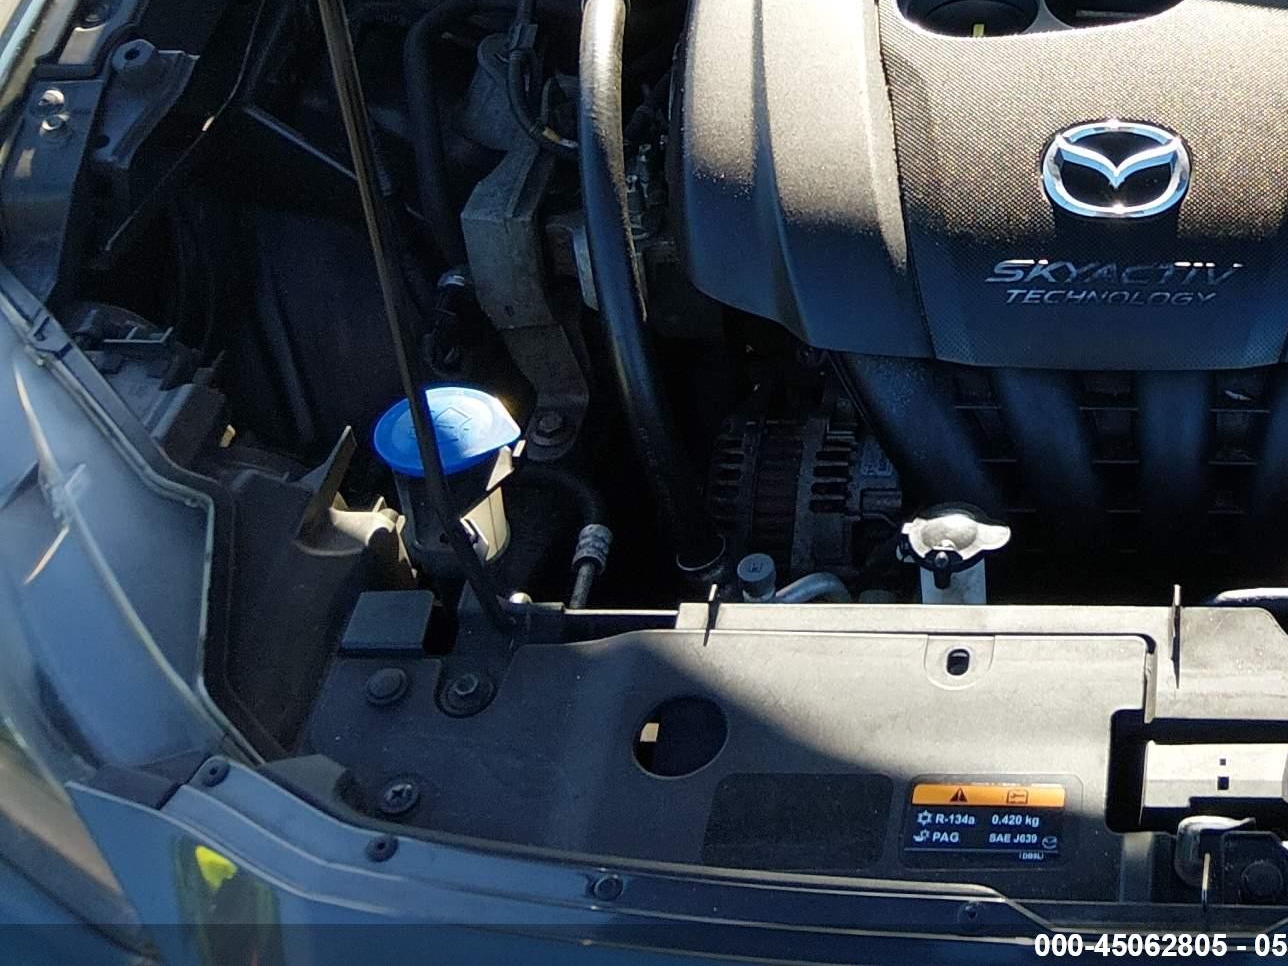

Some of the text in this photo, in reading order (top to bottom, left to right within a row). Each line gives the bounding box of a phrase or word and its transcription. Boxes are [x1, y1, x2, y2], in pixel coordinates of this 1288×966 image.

[985, 259, 1243, 284] SKYACTIV
[1005, 289, 1217, 305] TECHNOLOGY
[935, 813, 1040, 828] R-134a 0.420 kg
[932, 832, 960, 843] PAG
[989, 833, 1011, 843] SAE
